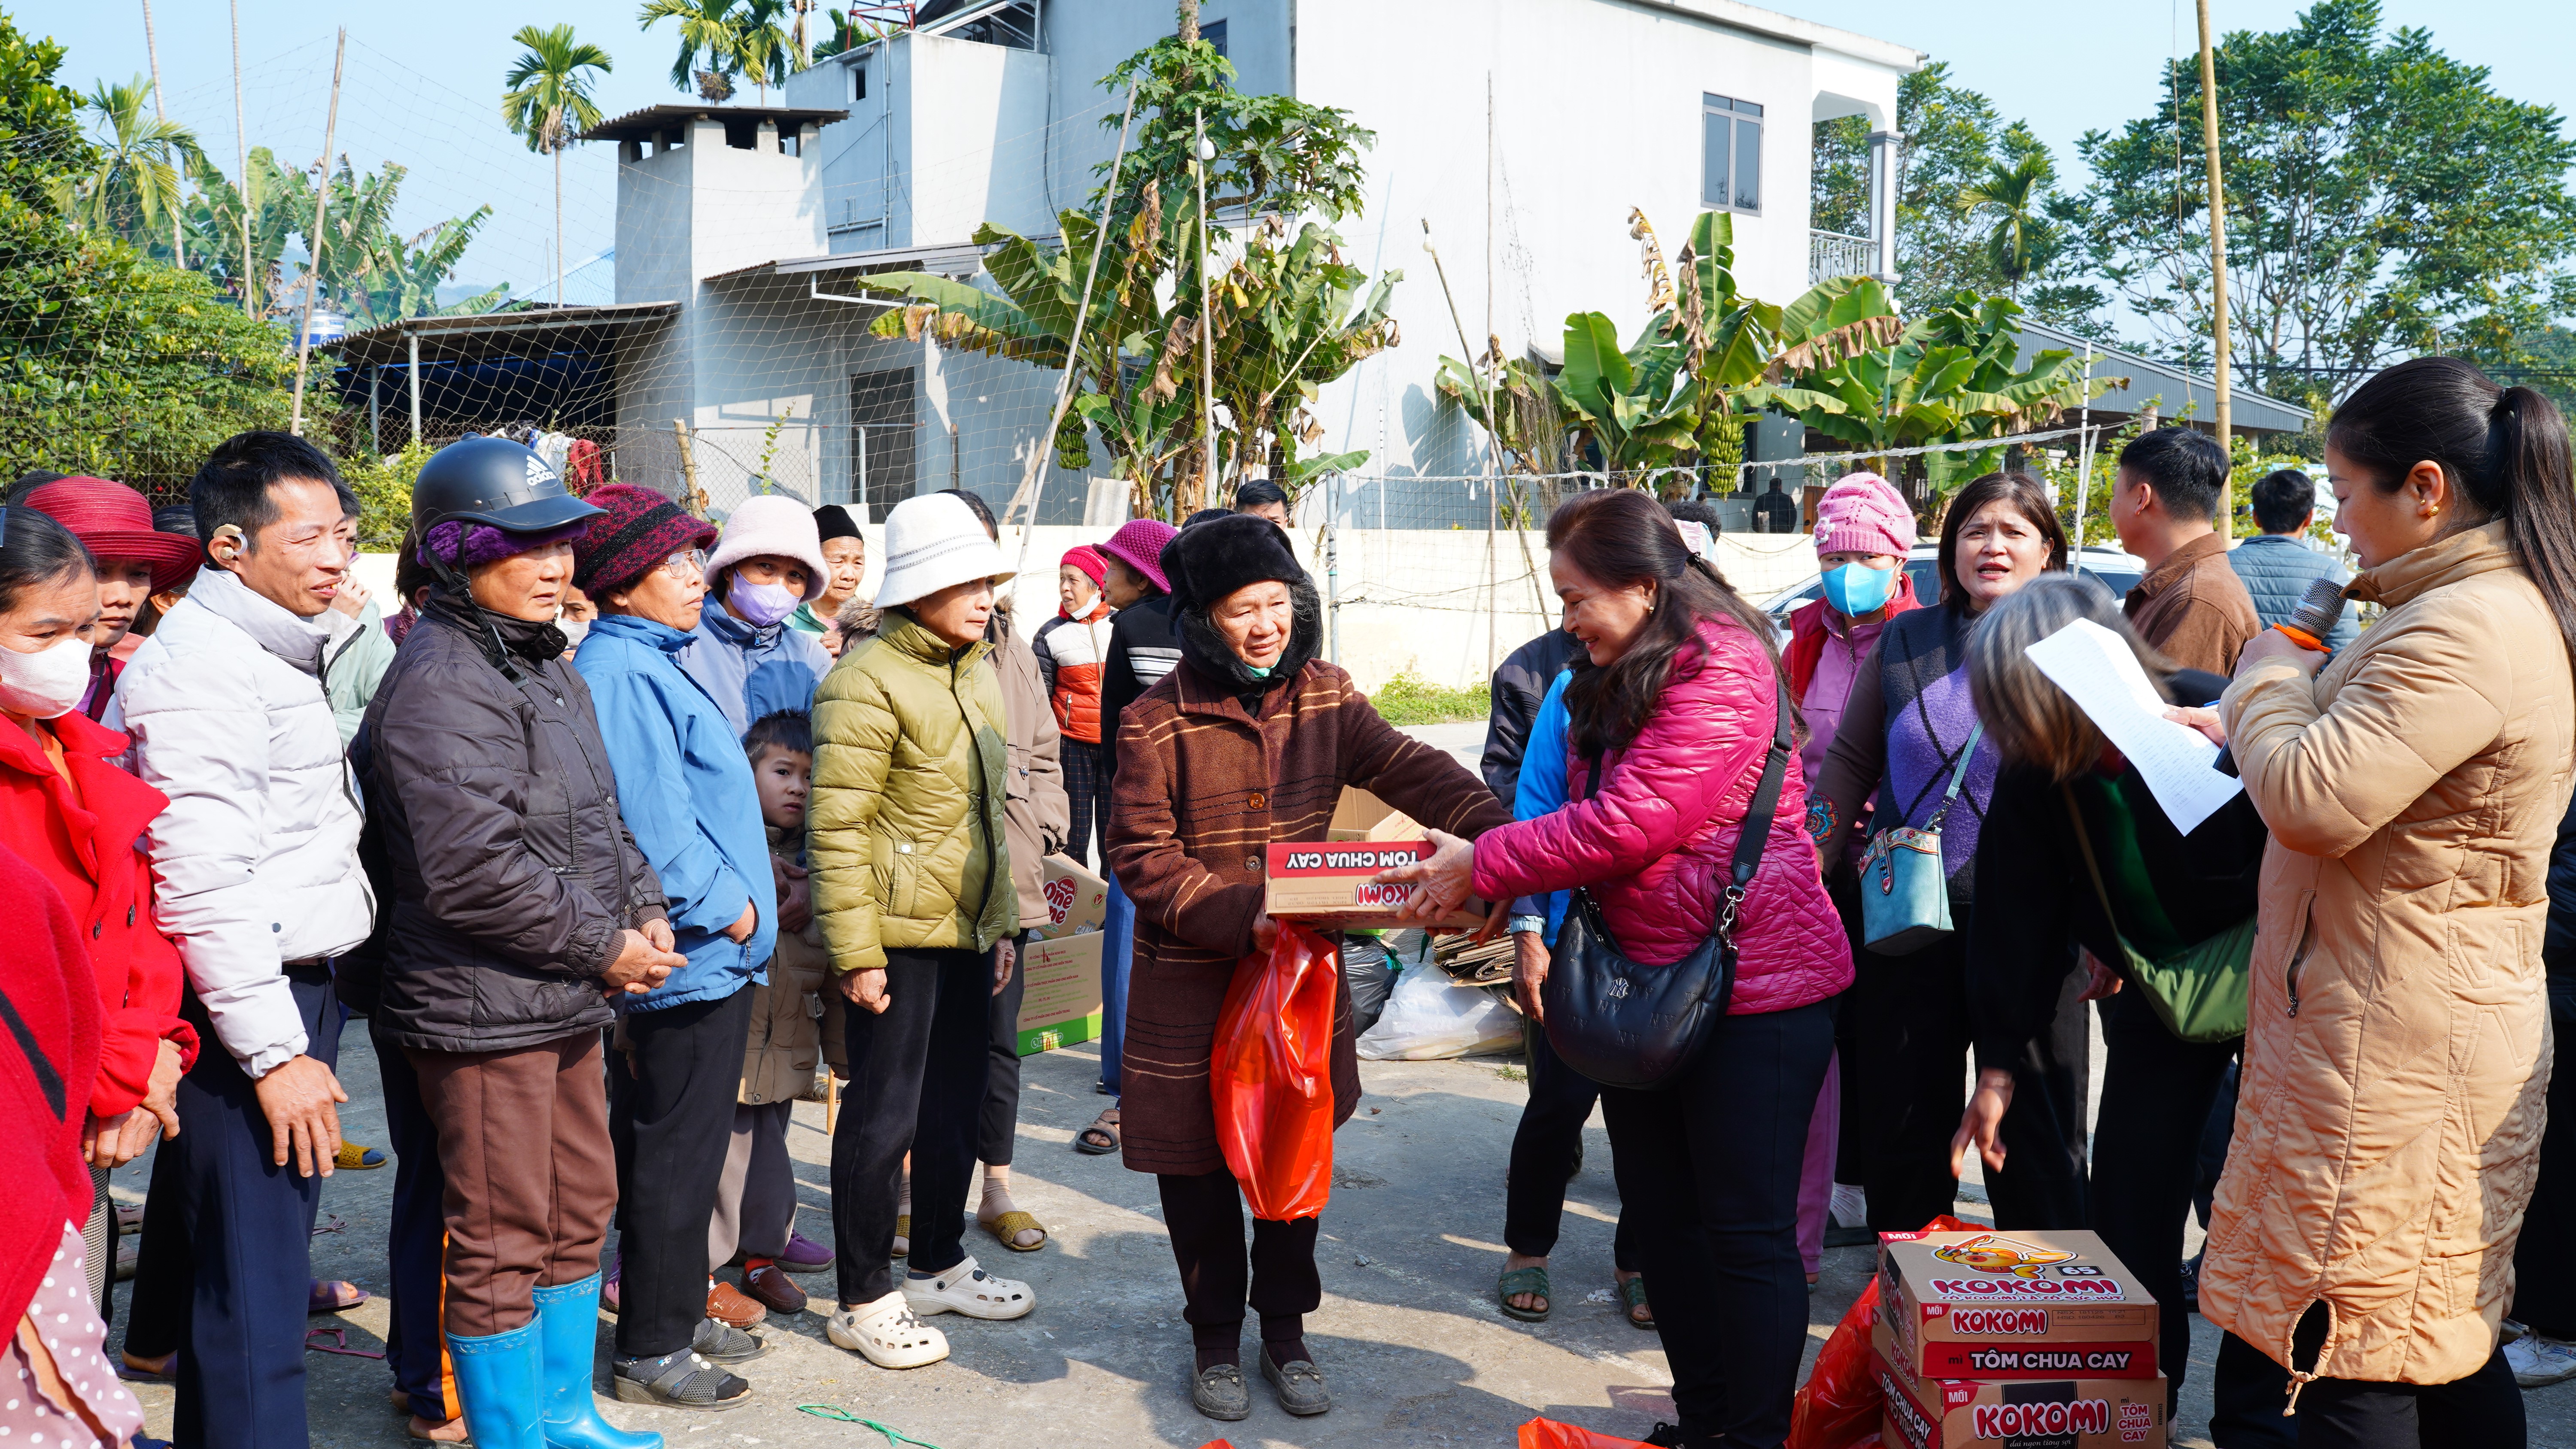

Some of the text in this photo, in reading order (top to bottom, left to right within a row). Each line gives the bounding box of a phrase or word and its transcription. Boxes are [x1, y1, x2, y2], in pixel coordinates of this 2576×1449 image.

[526, 470, 556, 486] adidas
[1287, 852, 1322, 868] CAY
[1326, 852, 1375, 867] CHUA
[1043, 882, 1073, 909] One
[1357, 883, 1418, 906] KOMI
[1049, 905, 1066, 924] ne
[1075, 925, 1096, 935] CAN
[1607, 977, 1629, 998] NY
[2062, 1266, 2098, 1275] 65
[1881, 1259, 1905, 1330] KOKOMI
[1931, 1279, 2120, 1294] KOKOMI
[1926, 1305, 1942, 1315] MỚI
[1952, 1310, 2047, 1333] KOKOMI
[1891, 1338, 1919, 1391] KOKOMI
[1948, 1349, 2130, 1368] mì TÔM CHUA CAY
[1948, 1389, 1968, 1403] MỚI
[1882, 1372, 1931, 1440] TÔM CHUA CAY
[2121, 1404, 2148, 1416] TÔM
[1974, 1400, 2108, 1438] KOKOMI
[2118, 1418, 2151, 1429] CHUA
[2010, 1440, 2021, 1448] dai
[2061, 1438, 2072, 1446] sợi
[2123, 1431, 2147, 1440] CAY
